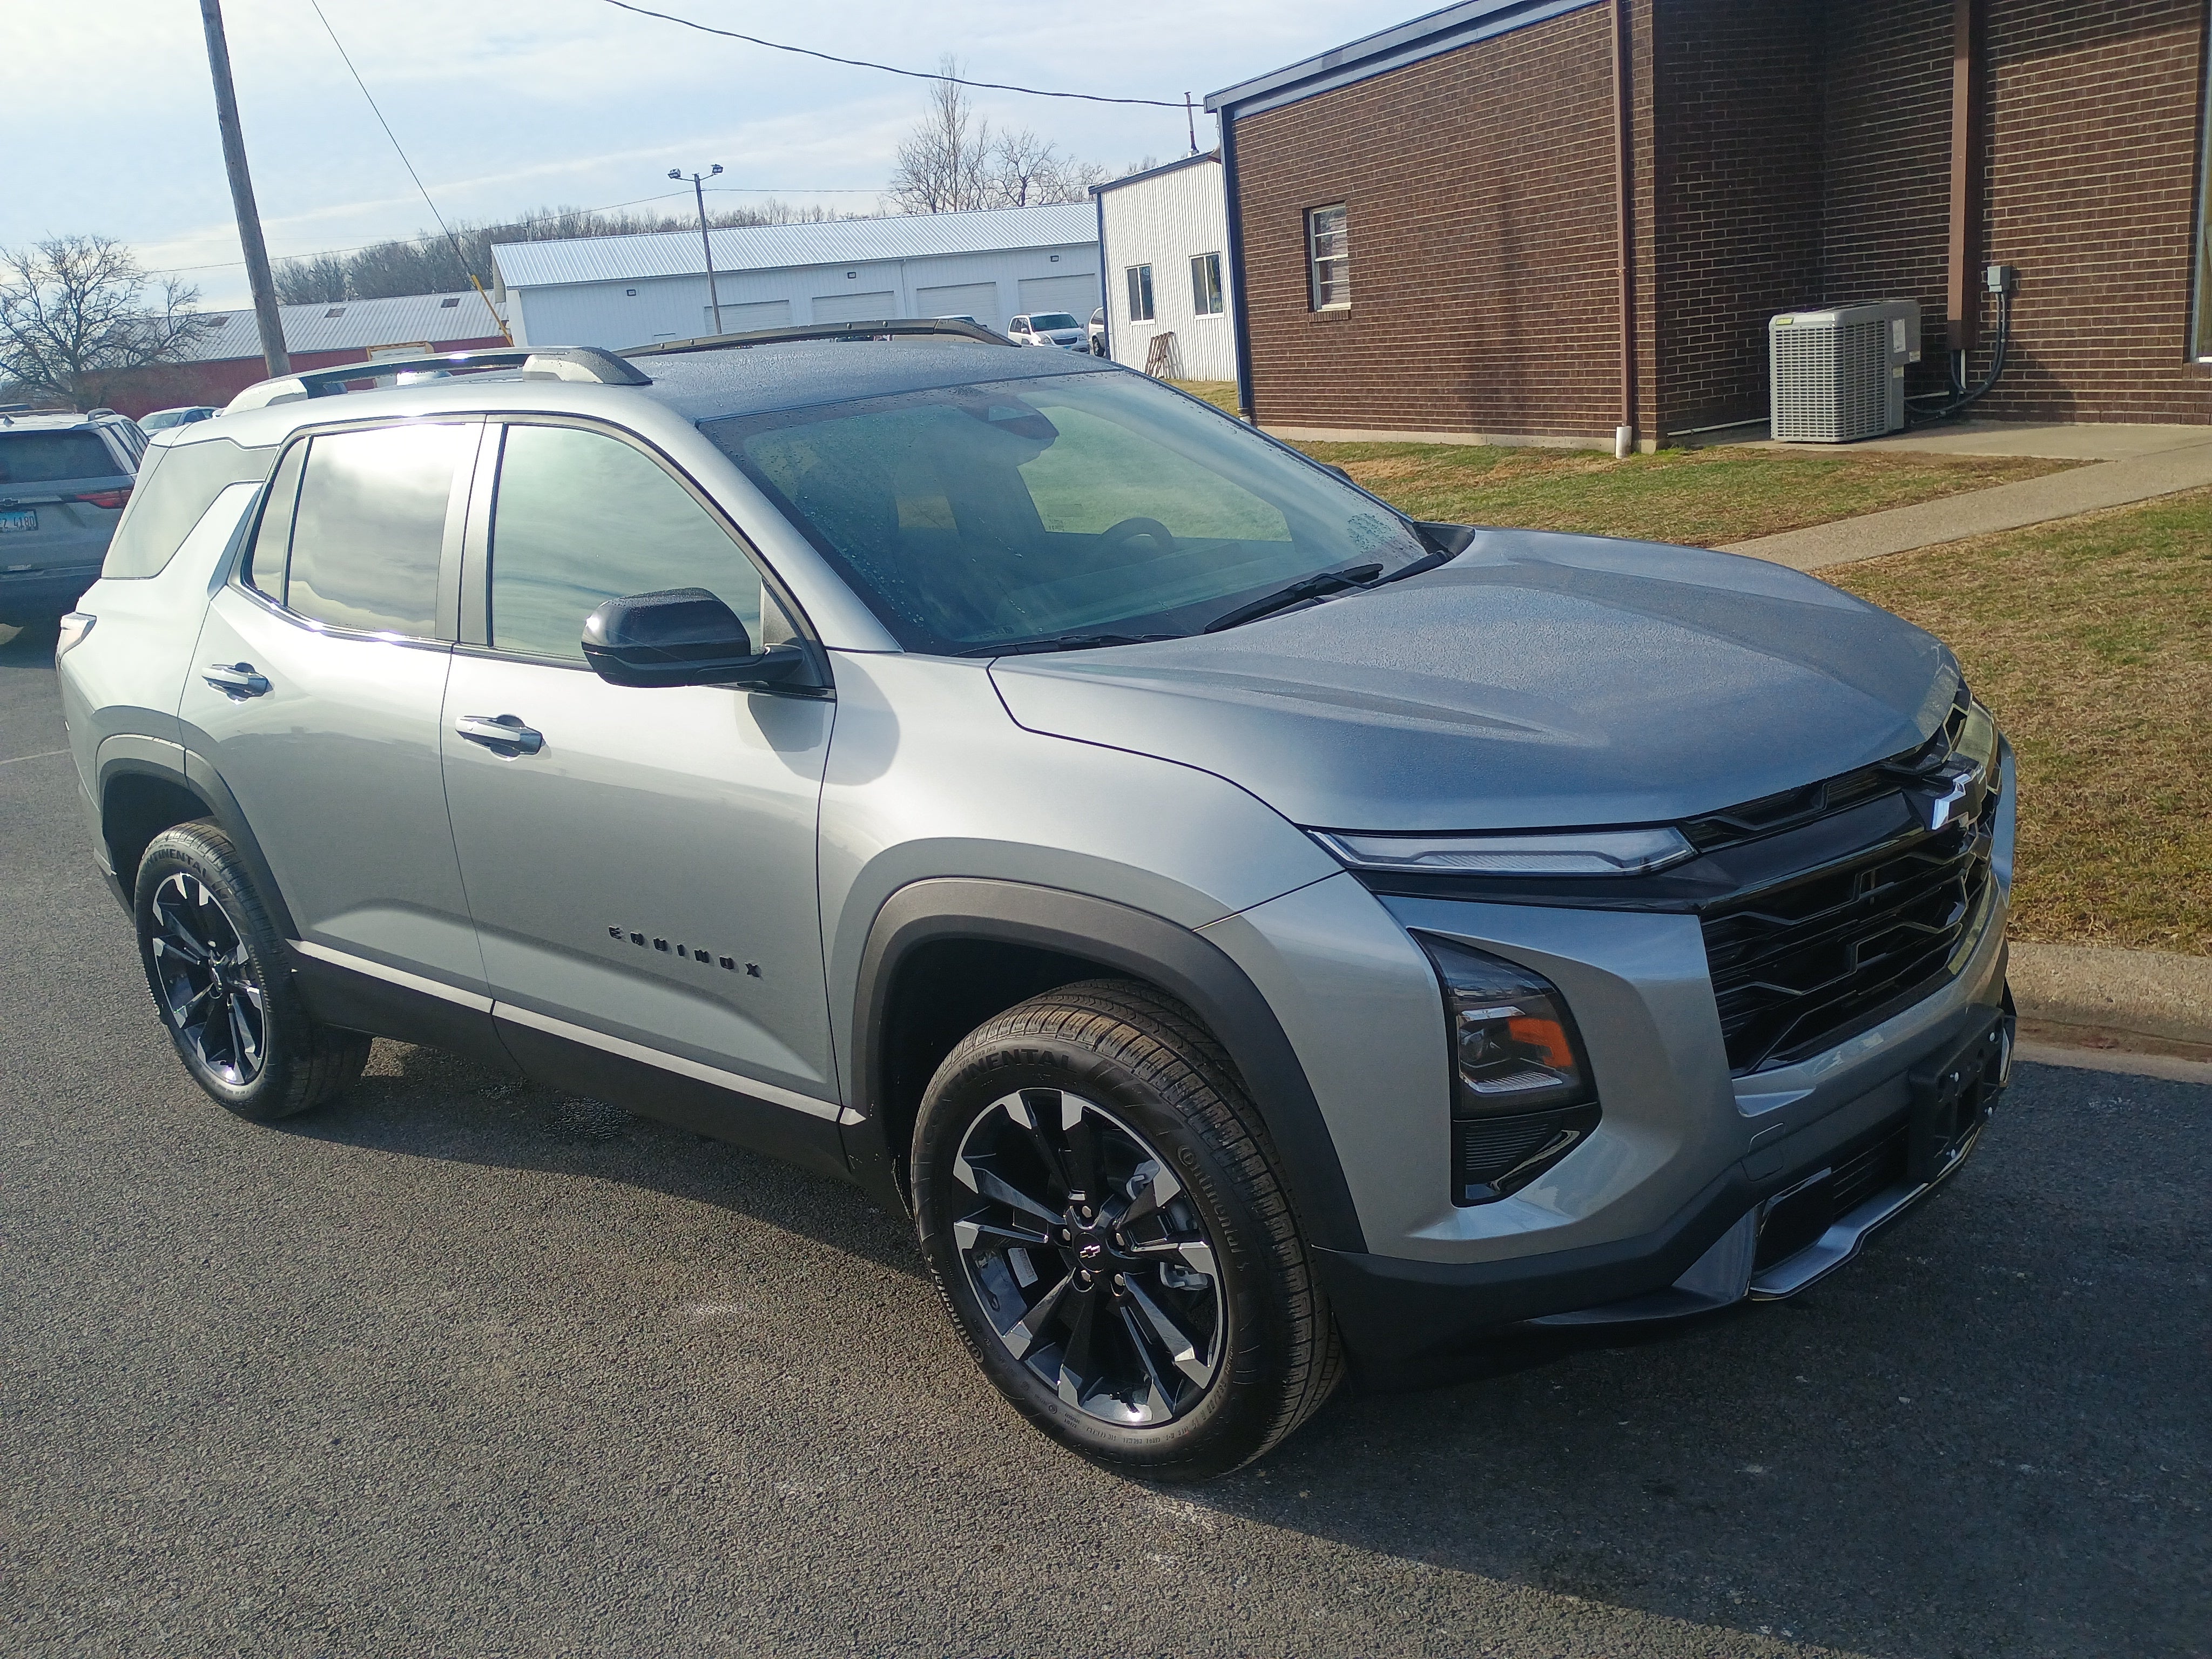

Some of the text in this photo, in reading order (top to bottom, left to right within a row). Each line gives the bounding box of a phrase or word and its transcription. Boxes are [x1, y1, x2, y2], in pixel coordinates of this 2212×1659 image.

[609, 926, 761, 978] EQUINOX
[1177, 1144, 1245, 1253] Continental
[930, 1269, 984, 1363] Continental
